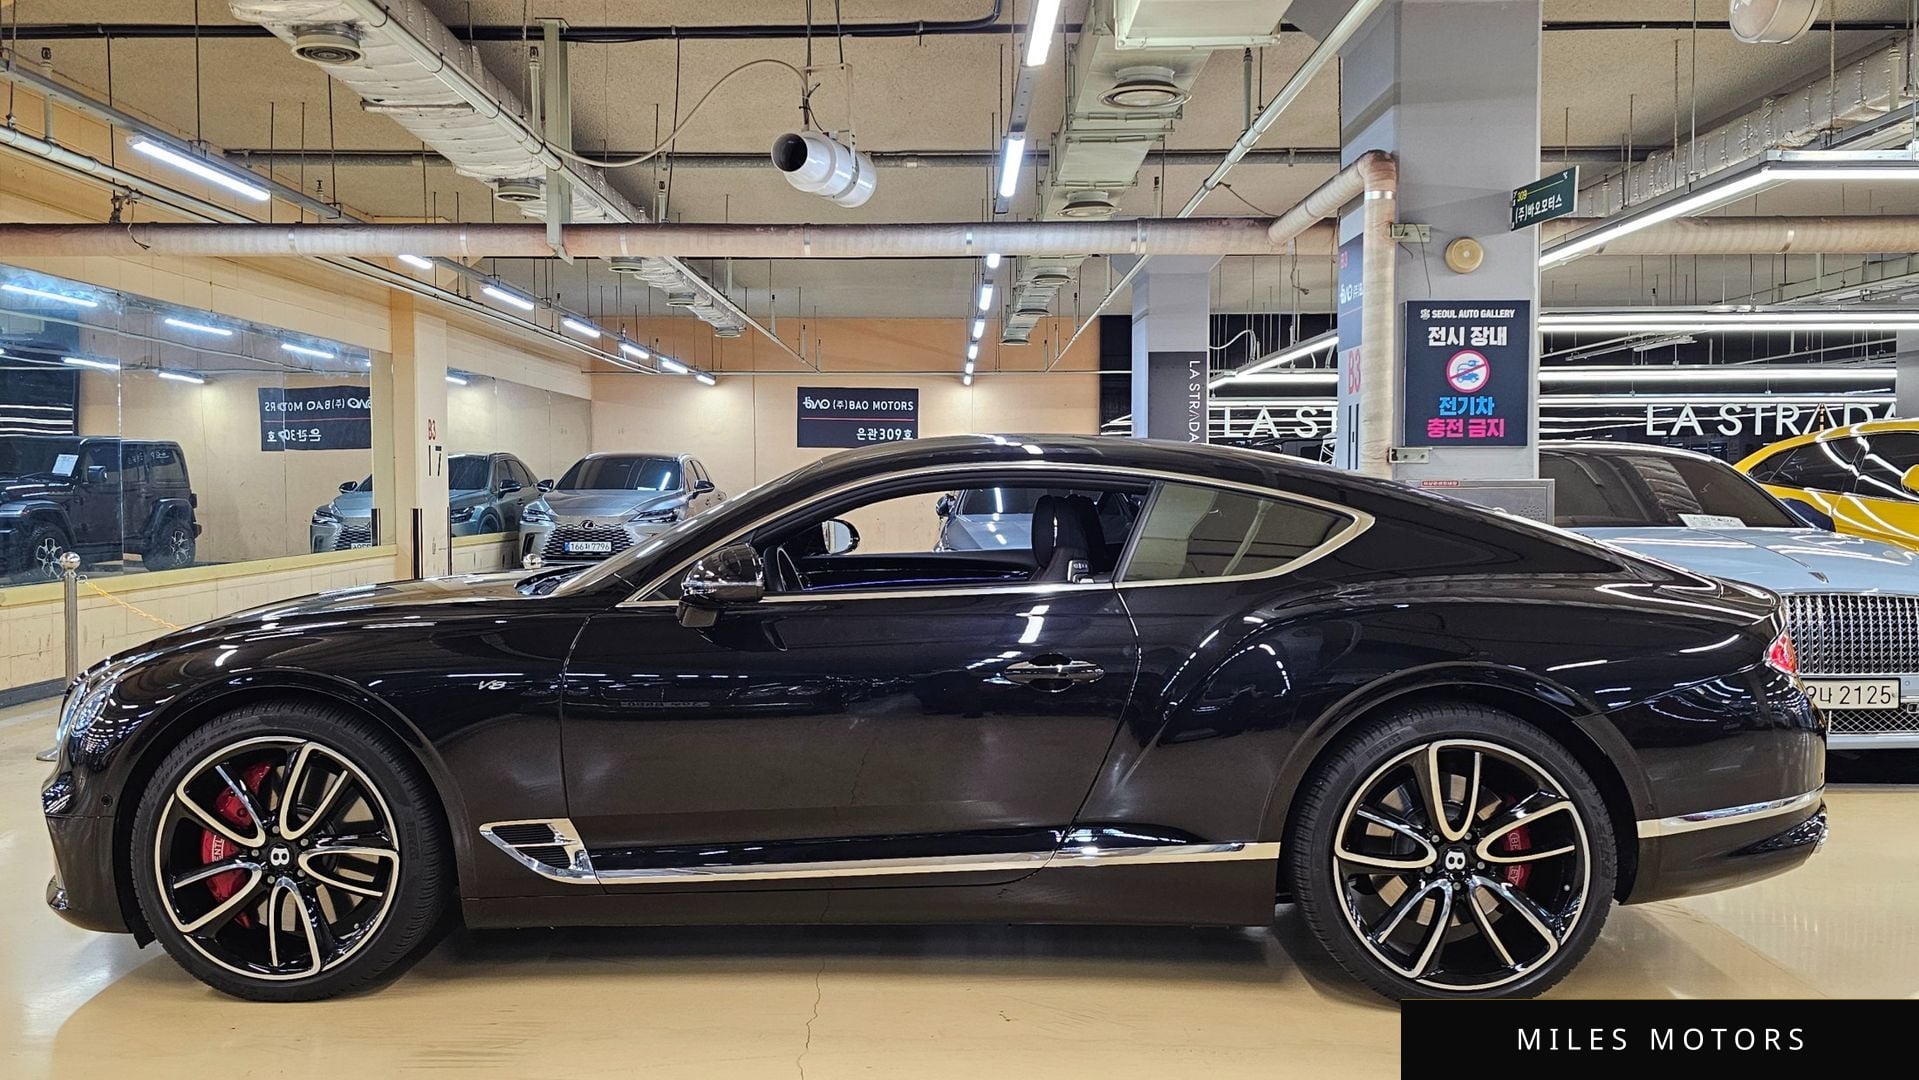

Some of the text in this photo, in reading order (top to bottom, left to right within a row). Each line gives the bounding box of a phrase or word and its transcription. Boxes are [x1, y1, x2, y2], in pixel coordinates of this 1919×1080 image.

[1515, 193, 1563, 224] (주)바오모터스
[1431, 309, 1516, 319] SEOUL AUTO GALLERY
[1428, 326, 1508, 346] 전시 장내
[1189, 360, 1201, 380] LA
[1348, 349, 1362, 394] B3
[872, 401, 915, 411] MOTORS
[1438, 396, 1496, 416] 전기차
[1224, 406, 1281, 439] LA
[1426, 418, 1505, 438] 충전 금지
[1646, 402, 1704, 436] LA
[427, 419, 437, 441] B3
[478, 679, 508, 691] V8
[1839, 685, 1892, 705] 2125
